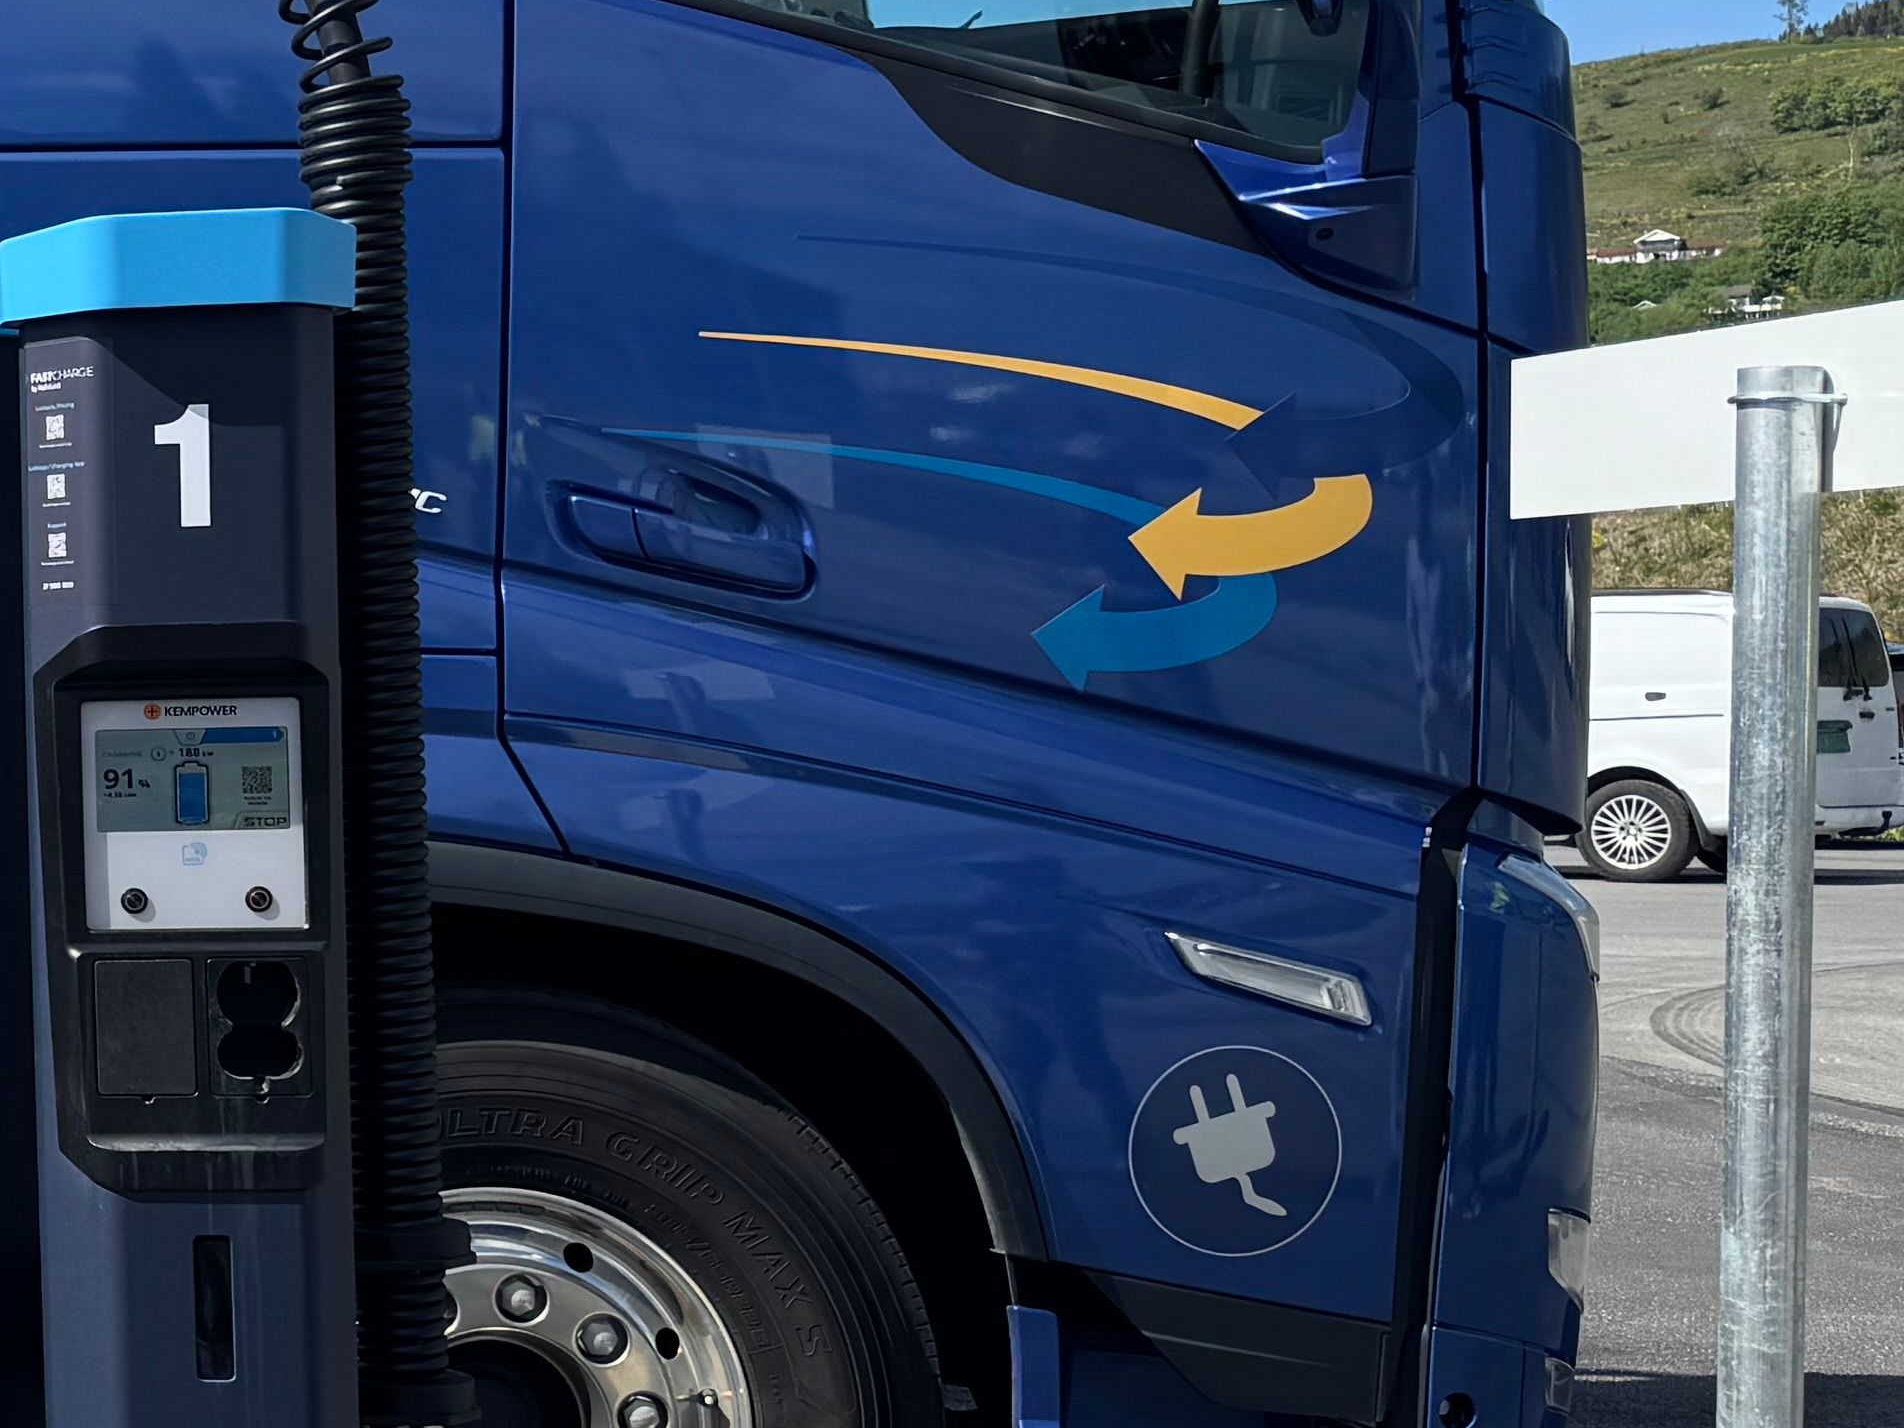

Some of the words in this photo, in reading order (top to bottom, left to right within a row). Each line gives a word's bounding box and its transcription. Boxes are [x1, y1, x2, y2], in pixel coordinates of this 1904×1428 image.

[154, 404, 211, 527] 1
[164, 705, 238, 717] KEMPOWER
[103, 768, 134, 789] 91
[244, 816, 287, 827] STOP
[439, 1106, 584, 1146] LTRA
[605, 1132, 726, 1205] GRIP
[721, 1210, 814, 1310] MAX
